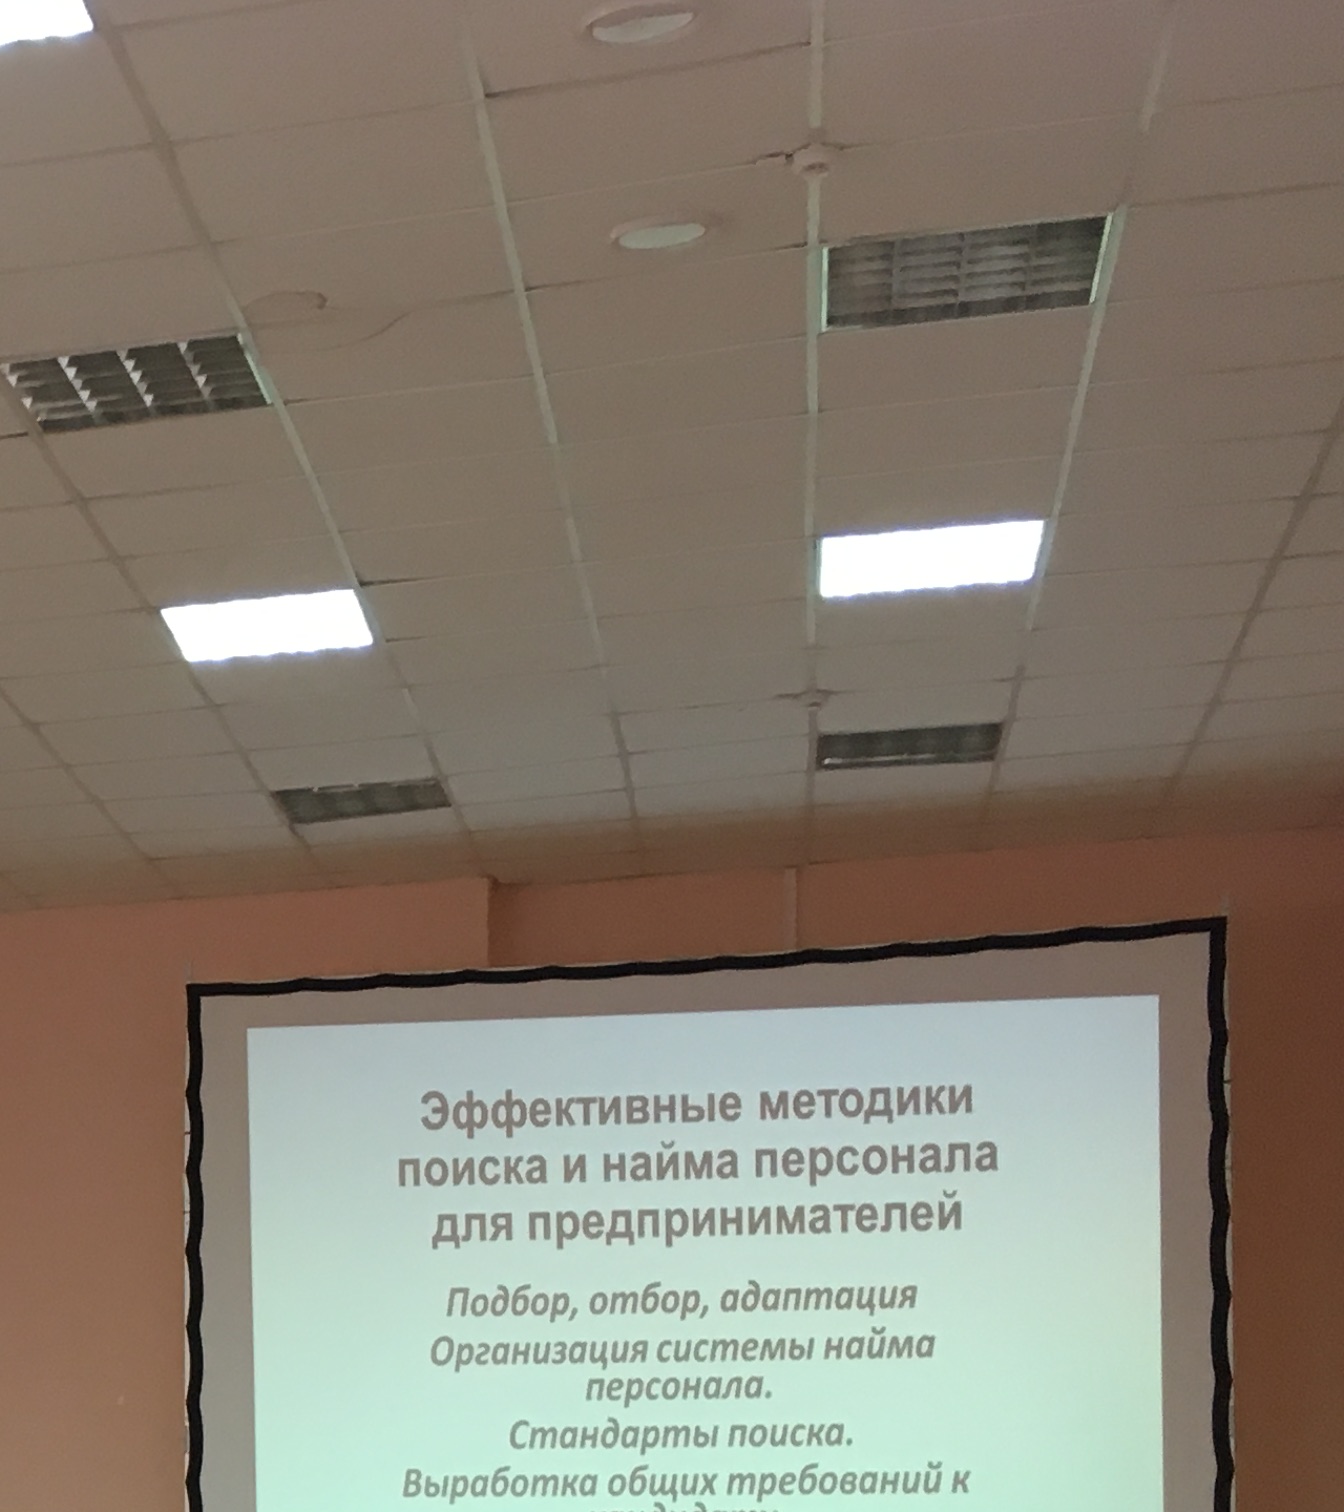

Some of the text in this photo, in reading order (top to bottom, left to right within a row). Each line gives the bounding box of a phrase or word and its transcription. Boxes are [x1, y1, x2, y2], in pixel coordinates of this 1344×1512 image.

[420, 1083, 973, 1139] Эффективные методики
[398, 1140, 999, 1187] поиска и найма персонала
[431, 1189, 963, 1250] для предпринимателей
[446, 1279, 918, 1323] Подбор, отбор, адаптация
[430, 1326, 936, 1373] Организация системы найма
[585, 1375, 772, 1408] персонала.
[509, 1416, 853, 1456] Стандарты поиска.
[402, 1461, 971, 1505] Выработка общих требований к
